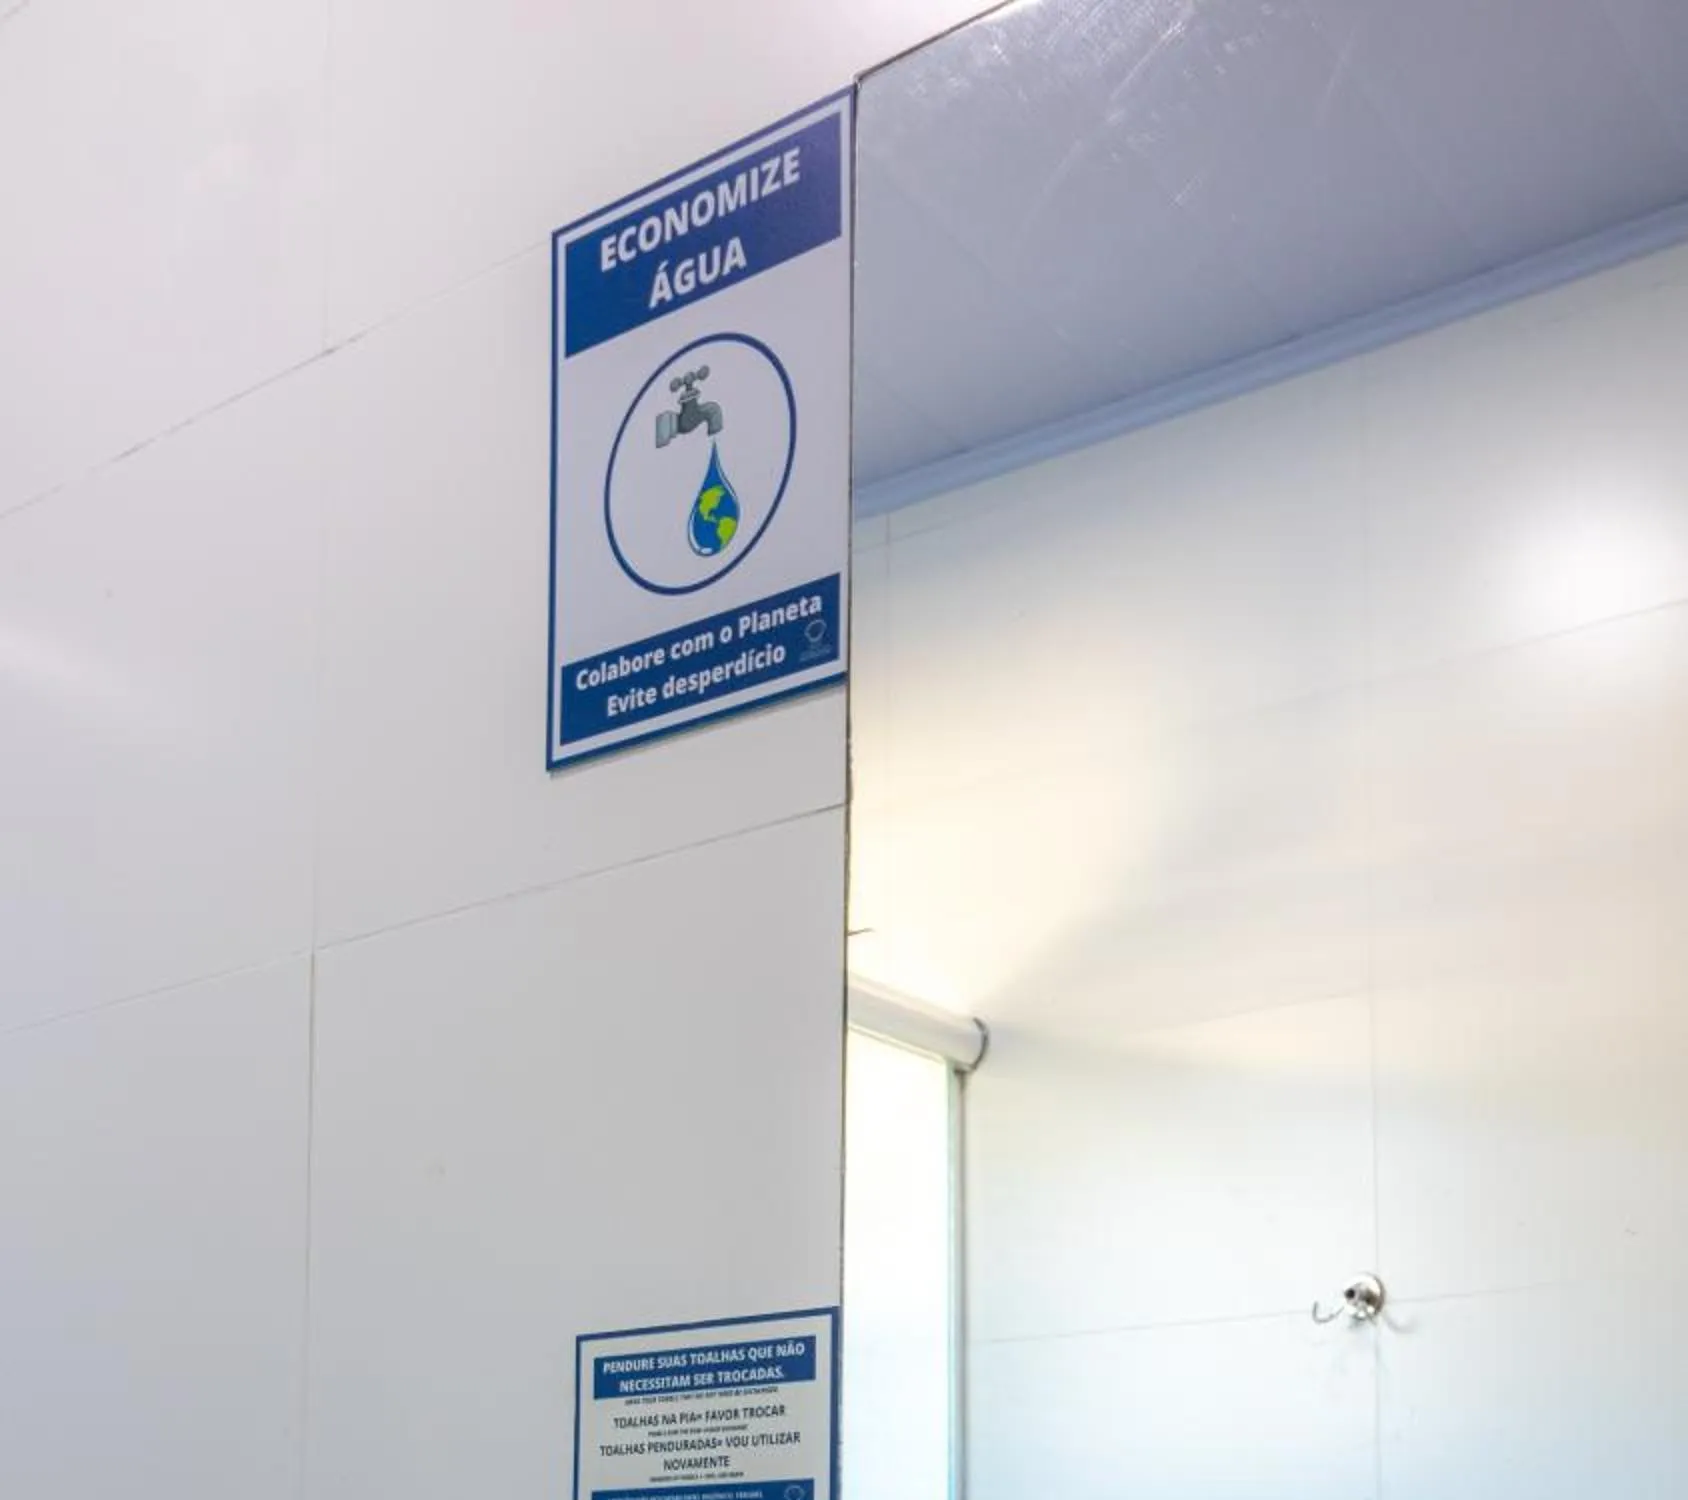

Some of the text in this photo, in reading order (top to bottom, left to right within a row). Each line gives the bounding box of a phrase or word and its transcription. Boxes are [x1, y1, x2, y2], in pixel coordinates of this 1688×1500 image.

[600, 146, 801, 273] ECONOMIZE
[648, 236, 748, 309] ÁGUA
[575, 595, 822, 690] Colabore com o Planeta
[606, 687, 657, 718] Evite
[662, 644, 787, 697] desperdício
[603, 1341, 805, 1373] PENDURE SUAS TOALHAS QUE NÃO
[619, 1374, 691, 1393] NECESSITAM
[693, 1371, 715, 1386] SER
[613, 1413, 659, 1428] TOALHAS
[661, 1411, 676, 1426] NA
[705, 1407, 740, 1422] FAVOR
[743, 1403, 786, 1418] TROCAR
[600, 1442, 646, 1457] TOALHAS
[725, 1434, 750, 1449] VOU
[751, 1430, 801, 1447] UTILIZAR
[663, 1455, 731, 1471] NOVAMENTE
